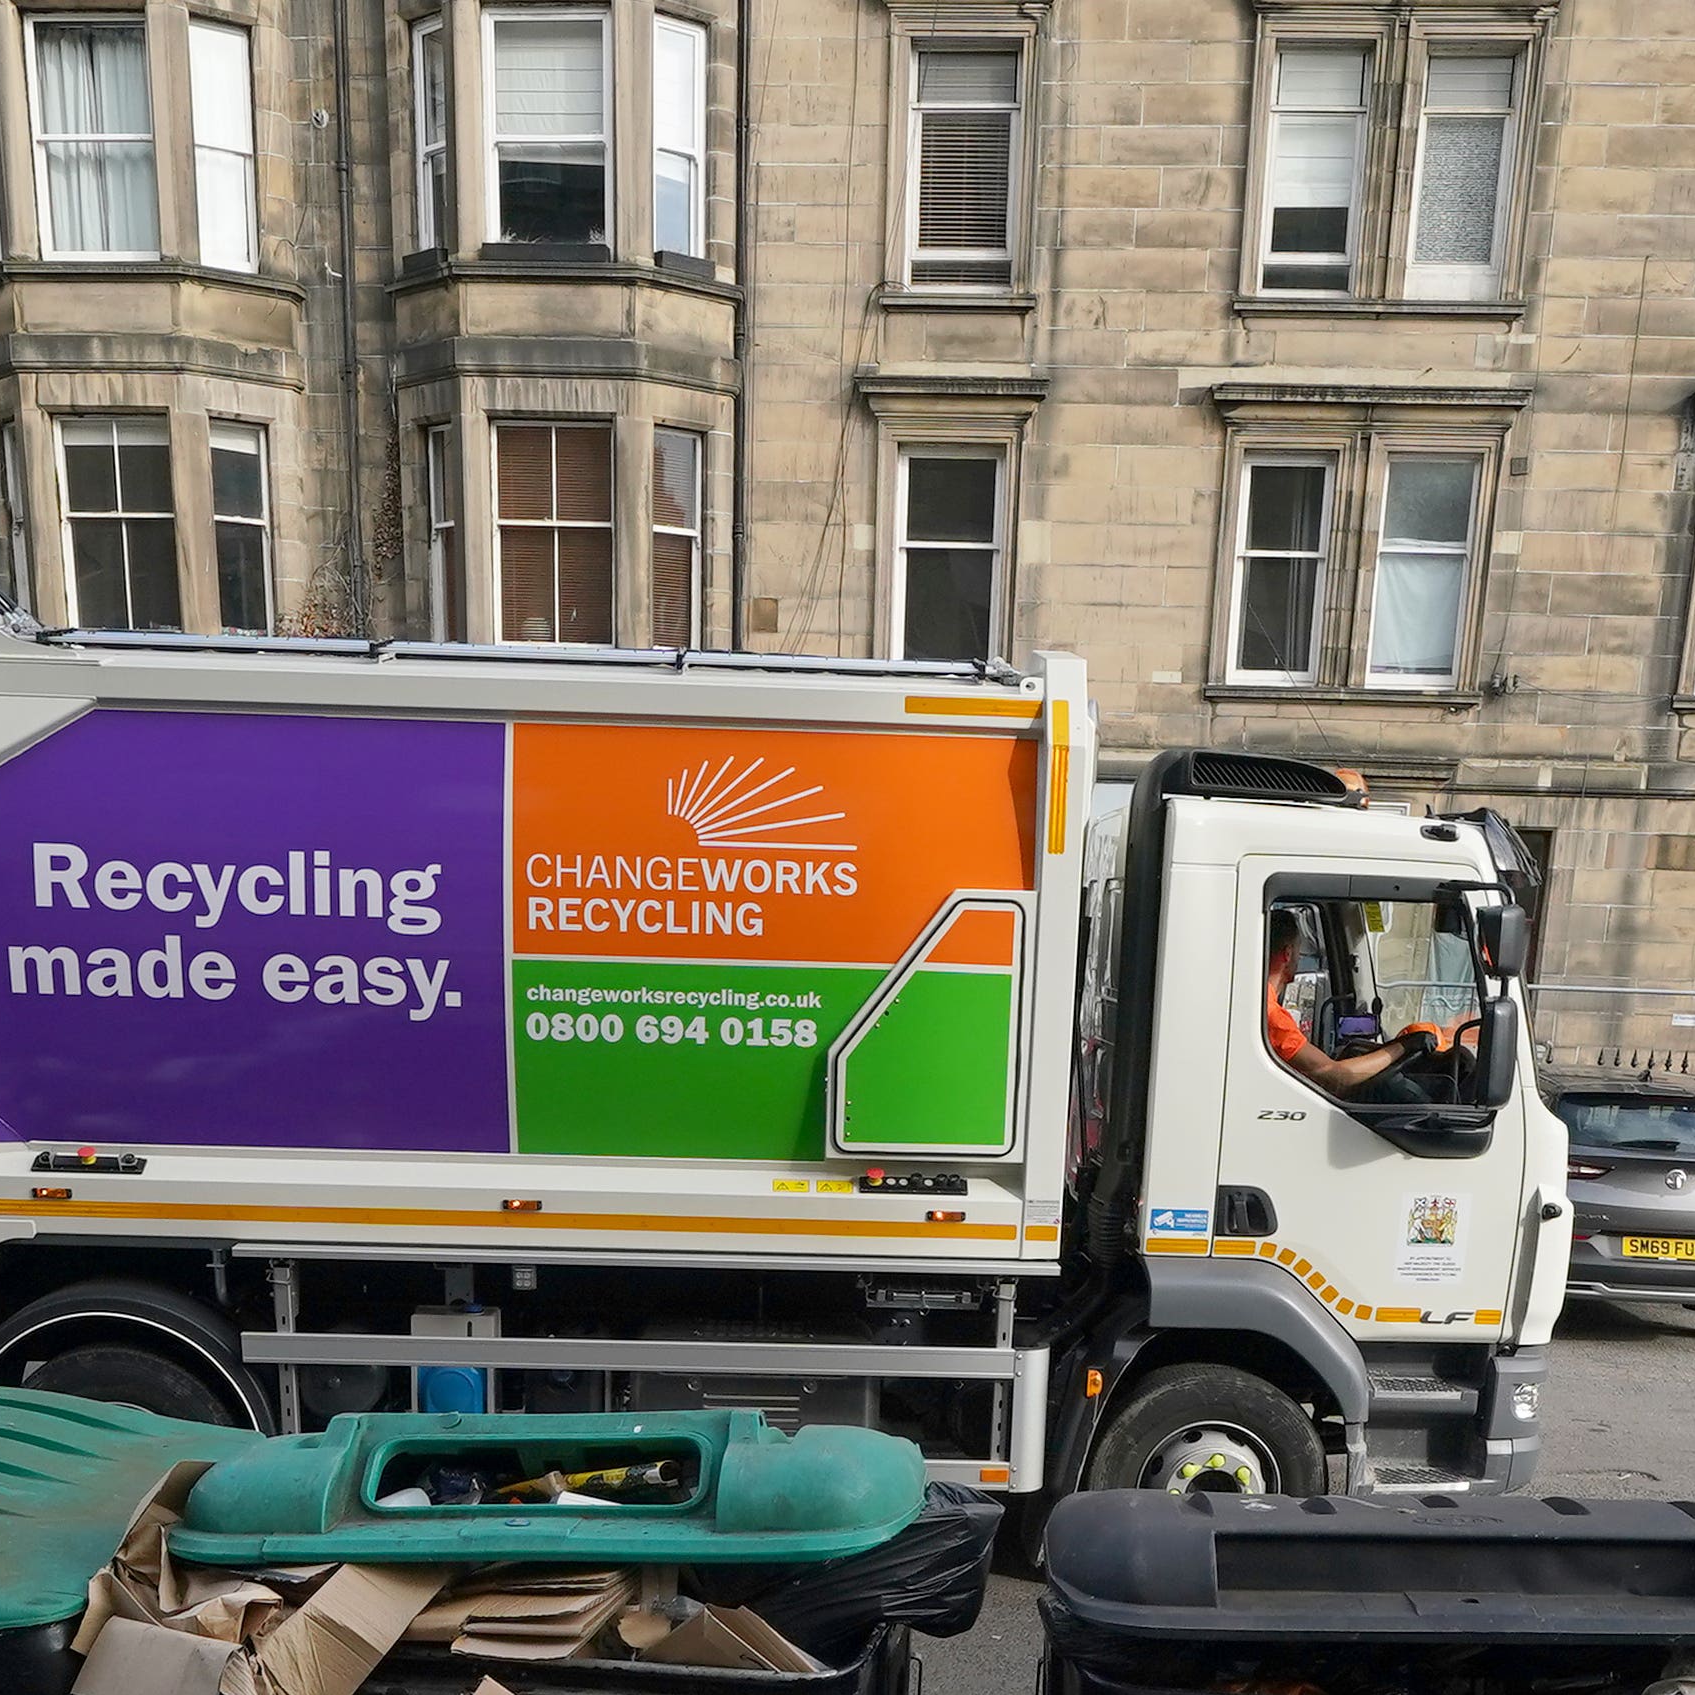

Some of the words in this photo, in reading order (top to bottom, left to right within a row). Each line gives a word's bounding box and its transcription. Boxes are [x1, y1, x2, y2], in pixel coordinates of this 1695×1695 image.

[31, 841, 443, 936] Recycling
[525, 852, 859, 896] CHANGEWORKS
[527, 896, 764, 938] RECYCLING
[7, 934, 237, 1001] made
[262, 951, 463, 1022] easy.
[525, 984, 823, 1011] changeworksrecycling.co.uk
[525, 1012, 625, 1044] 0800
[635, 1014, 710, 1046] 694
[720, 1017, 819, 1049] 0158
[1257, 1109, 1307, 1121] 230
[1629, 1237, 1670, 1255] SM69
[1420, 1310, 1474, 1325] LF
